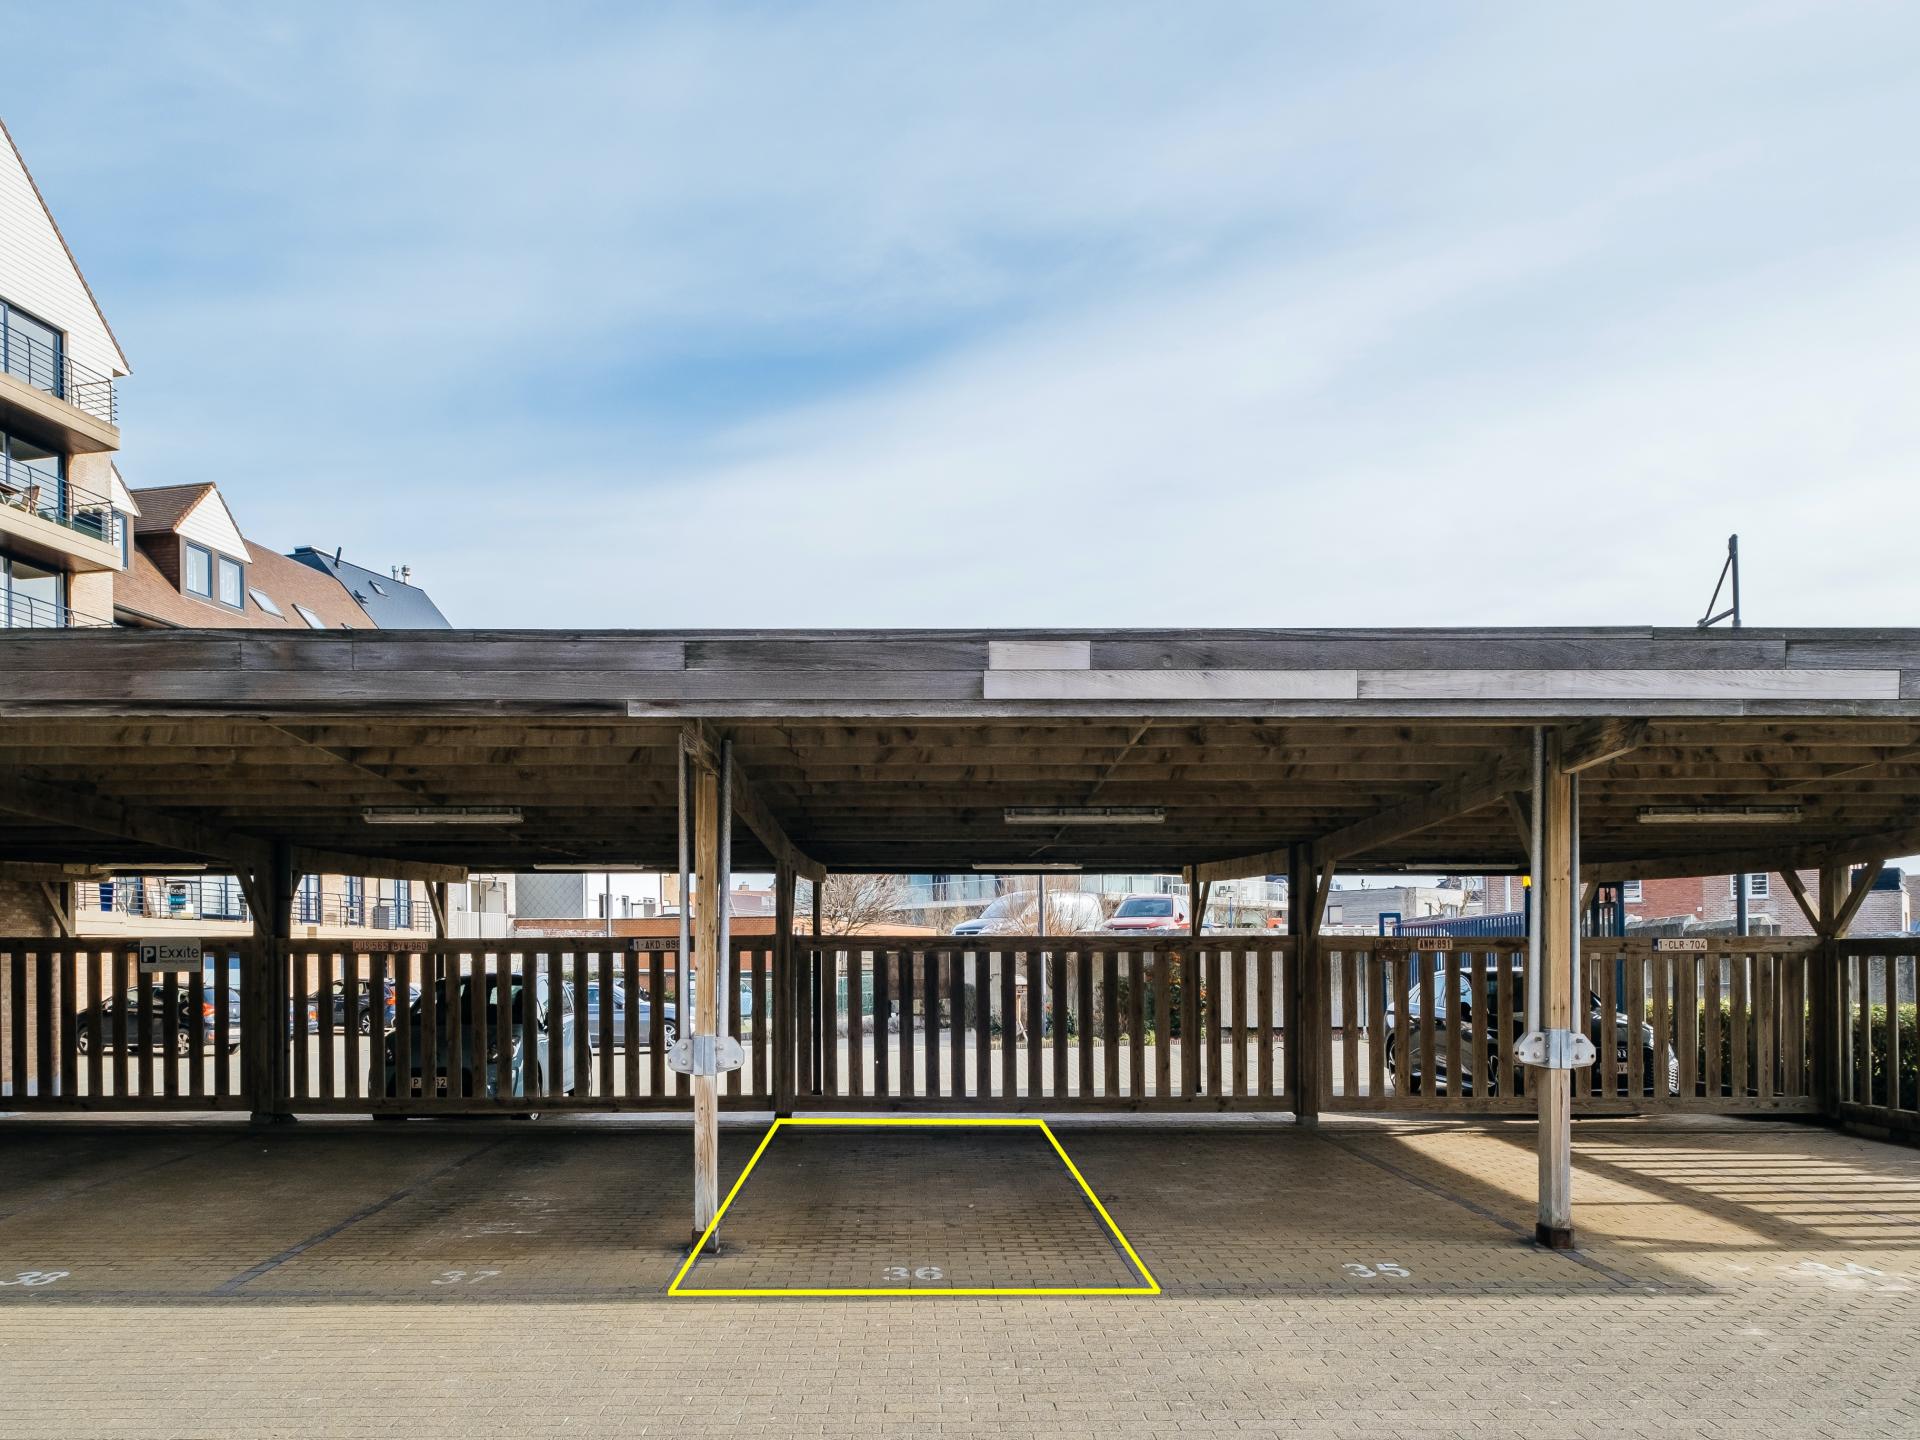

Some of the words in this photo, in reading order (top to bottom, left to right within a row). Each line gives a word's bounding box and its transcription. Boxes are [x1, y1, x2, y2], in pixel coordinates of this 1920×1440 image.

[1658, 940, 1706, 949] 1-CLR-704
[143, 947, 155, 962] P
[159, 945, 199, 958] Exxite
[430, 1270, 503, 1285] 37
[882, 1266, 943, 1281] 36
[1341, 1263, 1410, 1278] 35
[0, 1271, 70, 1286] 38
